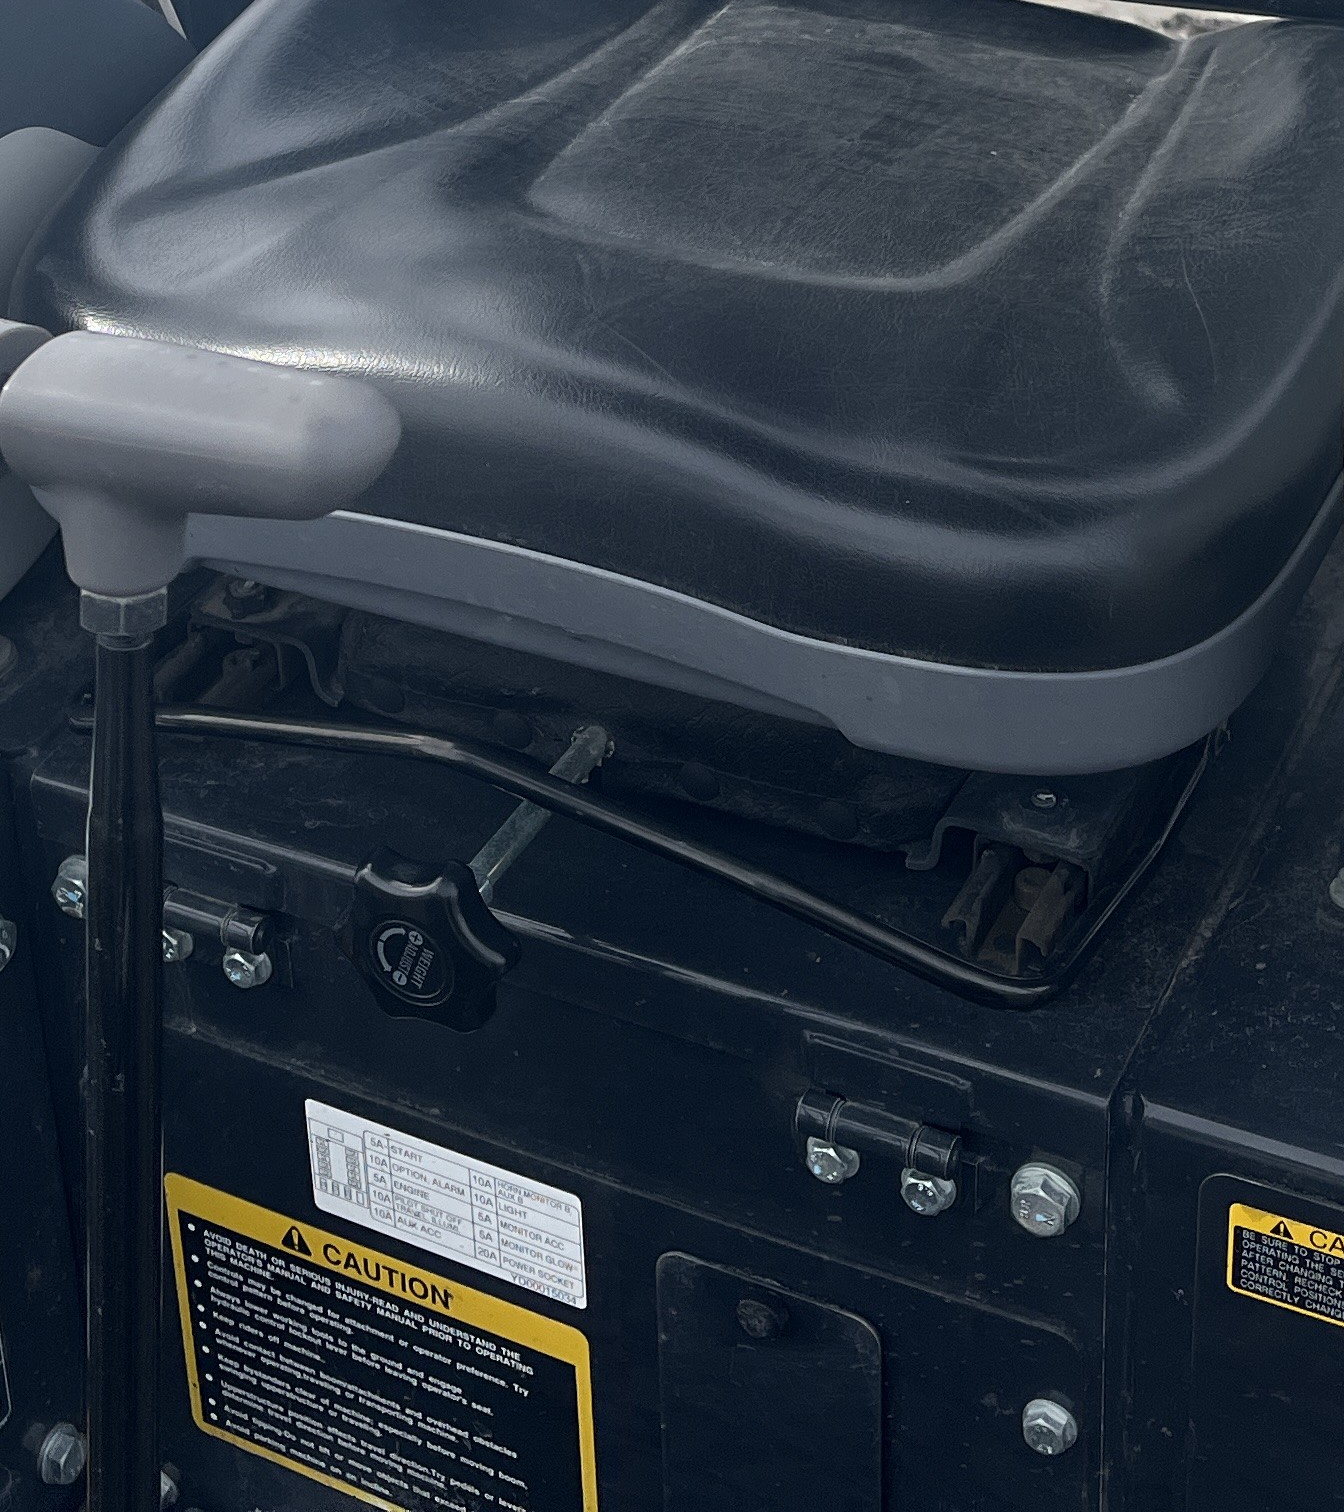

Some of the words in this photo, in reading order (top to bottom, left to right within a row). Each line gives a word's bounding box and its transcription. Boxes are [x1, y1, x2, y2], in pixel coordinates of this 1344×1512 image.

[410, 947, 435, 989] WEIGHT
[389, 1145, 423, 1163] START
[369, 1154, 388, 1169] 10A
[431, 1177, 465, 1197] ALARM
[472, 1174, 492, 1190] 10A
[372, 1189, 392, 1204] 10A
[474, 1193, 494, 1208] 10A
[498, 1201, 527, 1220] LIGHT
[374, 1207, 393, 1222] 10A
[420, 1225, 442, 1239] ACC
[544, 1236, 565, 1251] ACC
[1242, 1239, 1300, 1265] OPERATING
[1304, 1258, 1325, 1273] THE
[1261, 1235, 1288, 1251] SURE
[1293, 1245, 1308, 1257] TO
[1313, 1251, 1341, 1266] STOP
[477, 1246, 498, 1261] 20A
[502, 1255, 536, 1275] POWER
[1241, 1249, 1274, 1266] AFTER
[1278, 1260, 1333, 1286] CHANGING
[322, 1243, 452, 1310] CAUTION
[1240, 1268, 1288, 1292] CONTROL
[1240, 1278, 1300, 1304] CORRECTLY
[1294, 1275, 1343, 1299] RECHECK
[235, 1241, 267, 1261] DEATH
[403, 1309, 425, 1323] AND
[428, 1318, 497, 1352] UNDERSTAND
[500, 1346, 521, 1362] THE
[266, 1262, 307, 1286] MANUAL
[310, 1281, 331, 1295] AND
[376, 1306, 418, 1330] MANUAL
[421, 1324, 453, 1343] PRIOR
[456, 1338, 472, 1351] TO
[475, 1346, 534, 1376] OPERATING
